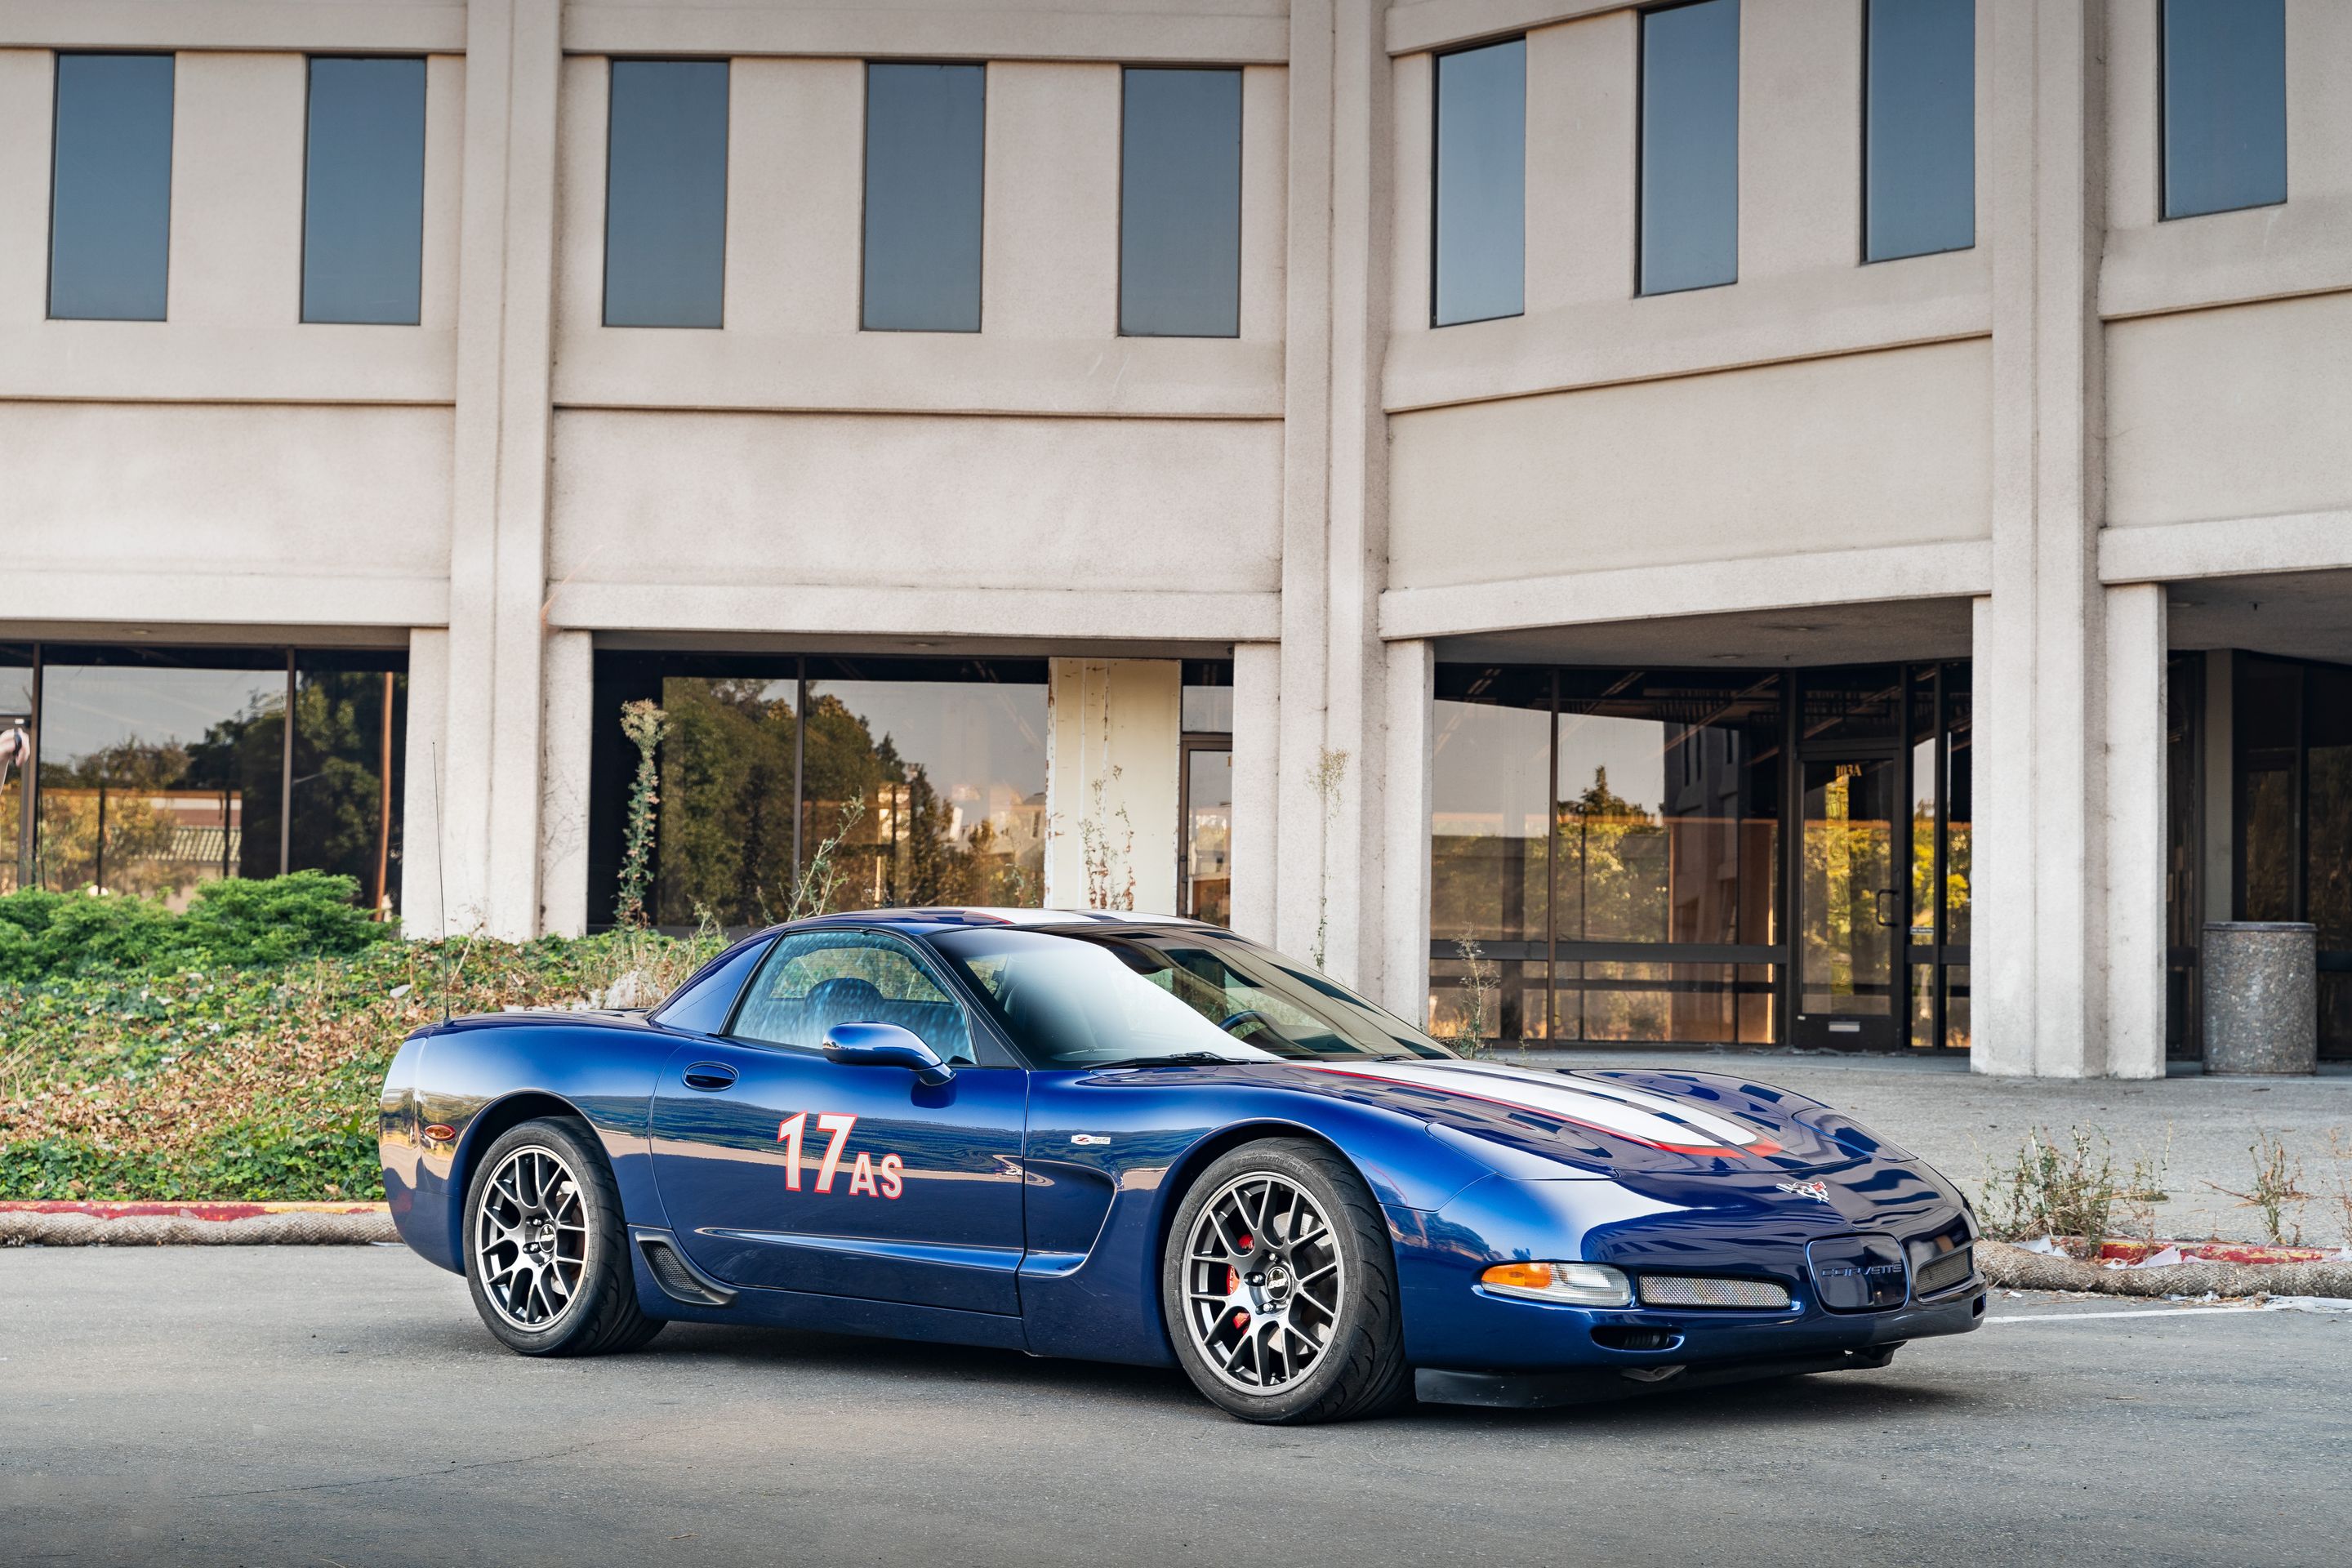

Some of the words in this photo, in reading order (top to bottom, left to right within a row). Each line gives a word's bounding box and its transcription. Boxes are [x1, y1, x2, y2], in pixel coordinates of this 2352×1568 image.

[777, 1111, 858, 1194] 17
[849, 1152, 903, 1200] AS
[1822, 1260, 1902, 1277] CORVETTE
